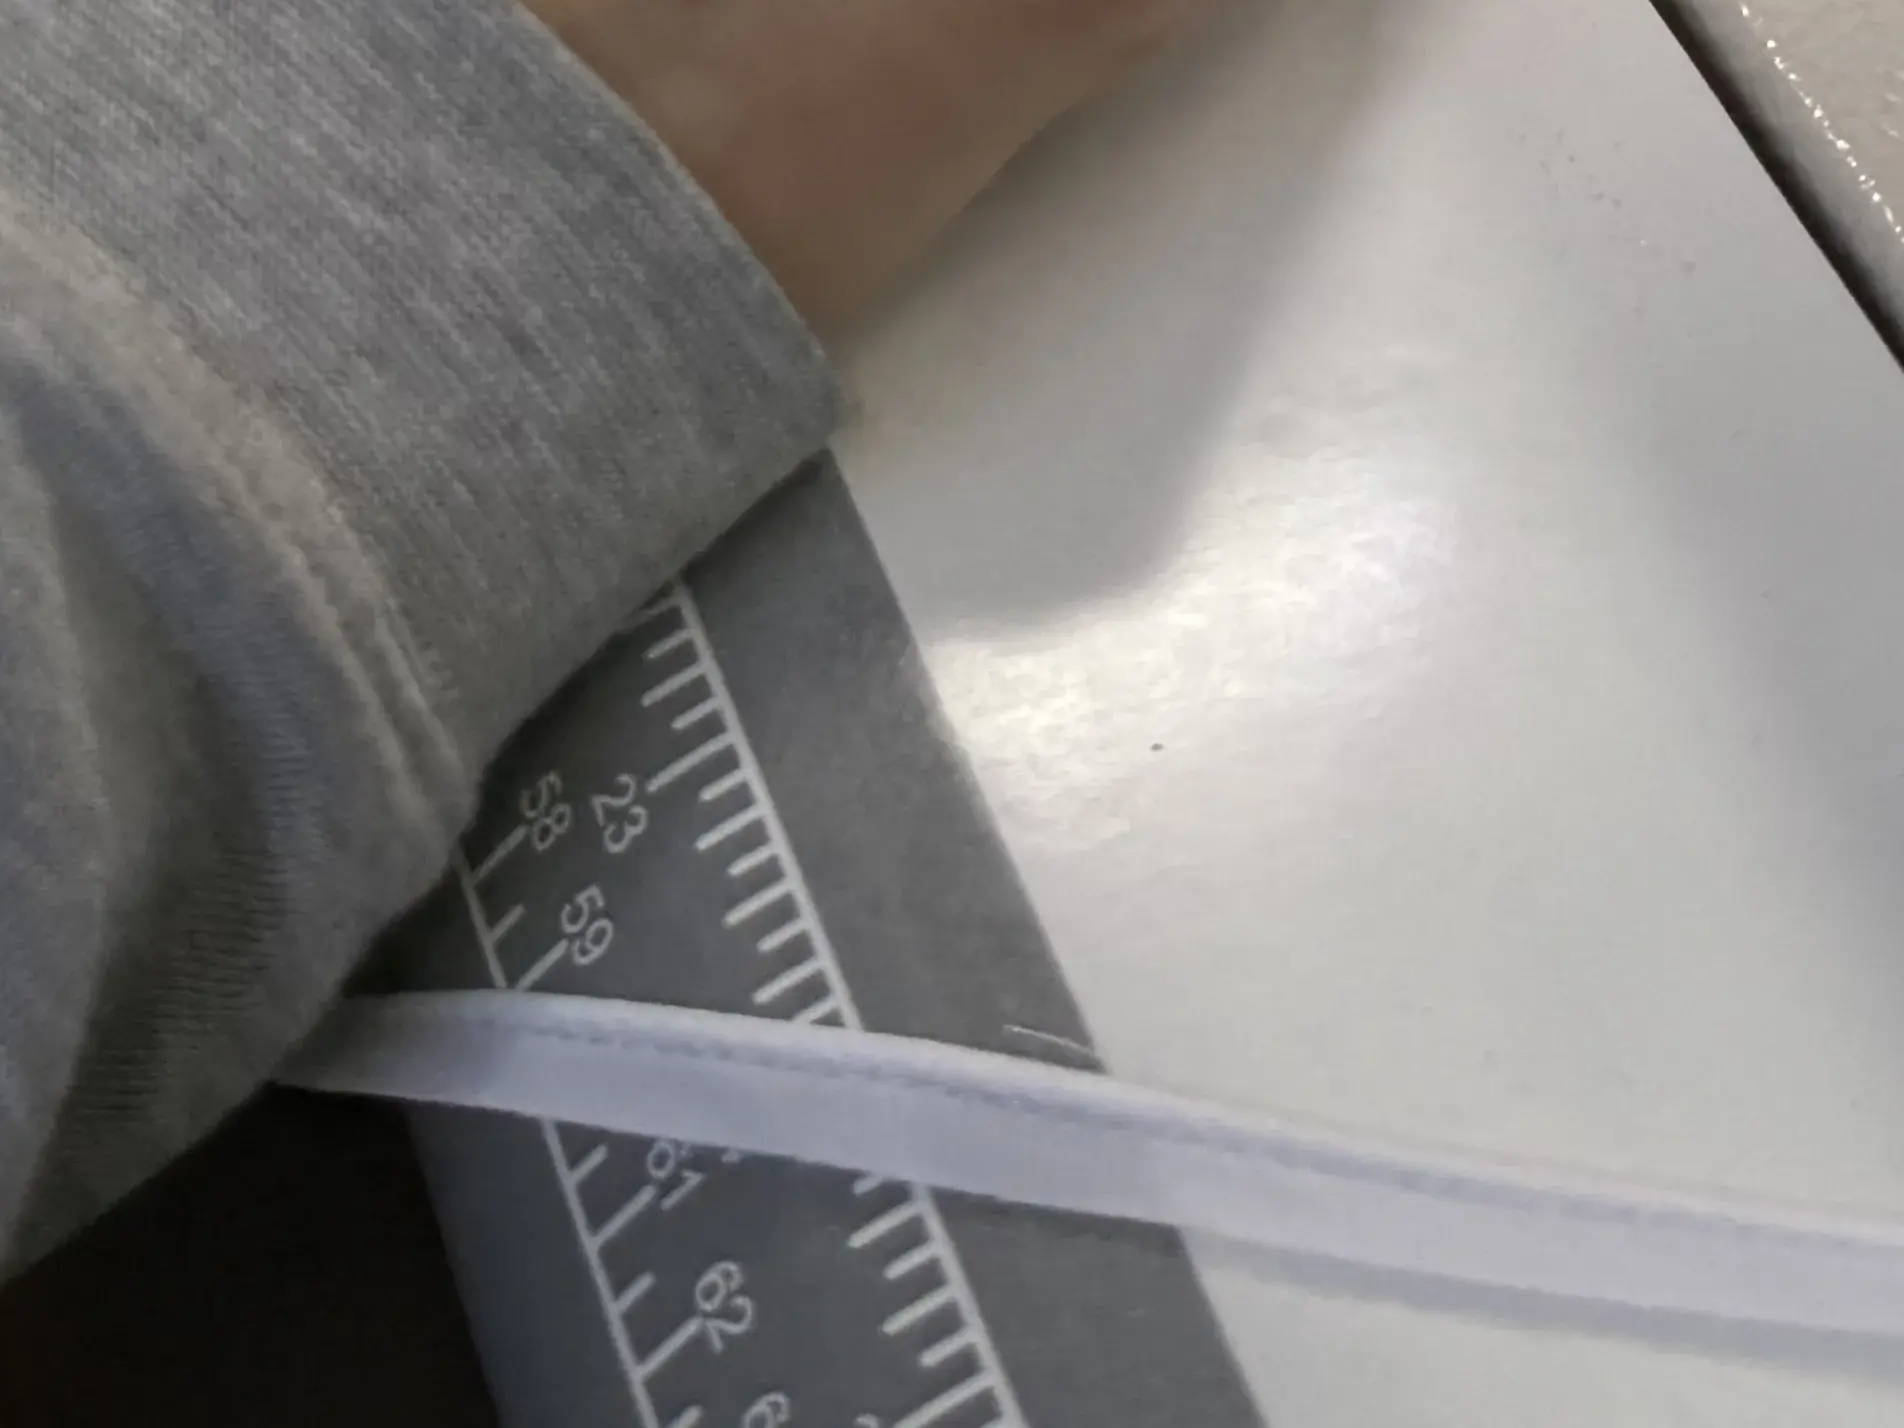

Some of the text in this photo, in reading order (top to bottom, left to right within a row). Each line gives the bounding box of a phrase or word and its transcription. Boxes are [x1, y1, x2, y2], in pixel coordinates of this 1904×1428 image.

[519, 770, 574, 853] 58
[589, 772, 650, 854] 23
[560, 883, 615, 966] 59
[694, 1259, 758, 1354] 62
[740, 1390, 792, 1428] 6
